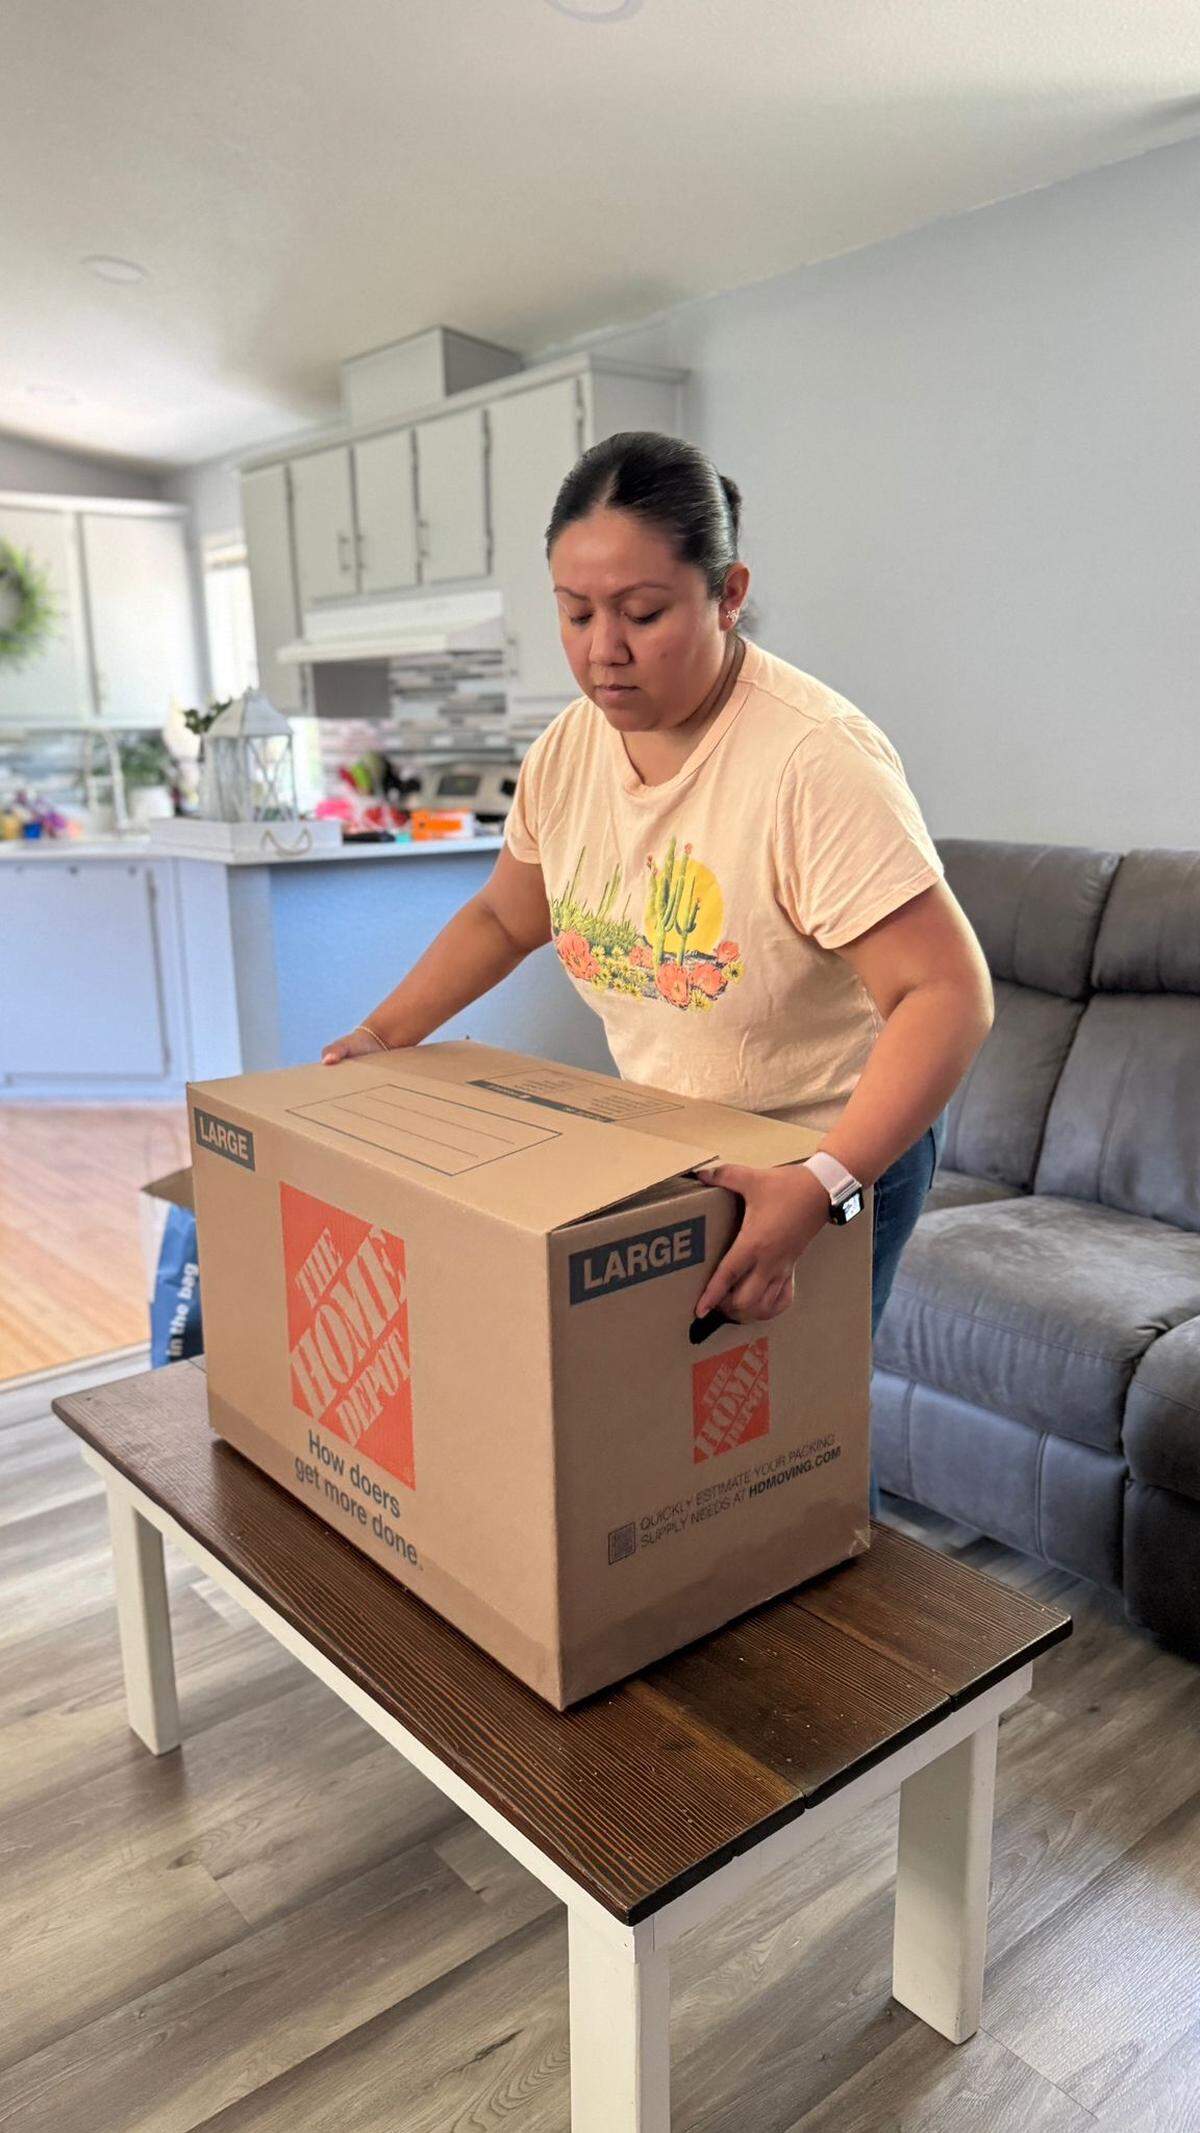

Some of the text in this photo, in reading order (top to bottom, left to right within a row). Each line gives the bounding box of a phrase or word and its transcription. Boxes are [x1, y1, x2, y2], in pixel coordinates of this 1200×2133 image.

[199, 1115, 249, 1161] LARGE
[295, 1226, 344, 1308] THE
[583, 1227, 693, 1290] LARGE
[289, 1224, 407, 1420] HOME
[335, 1327, 415, 1449] DEPOT
[693, 1337, 768, 1461] HOME
[722, 1379, 769, 1447] DEPOT
[294, 1456, 424, 1572] get more done.
[308, 1428, 401, 1519] How doers
[640, 1433, 836, 1531] QUICKLY ESTIMATE YOUR PACKING
[640, 1446, 842, 1548] SUPPLY NEEDS AT HDMOVING.COM
